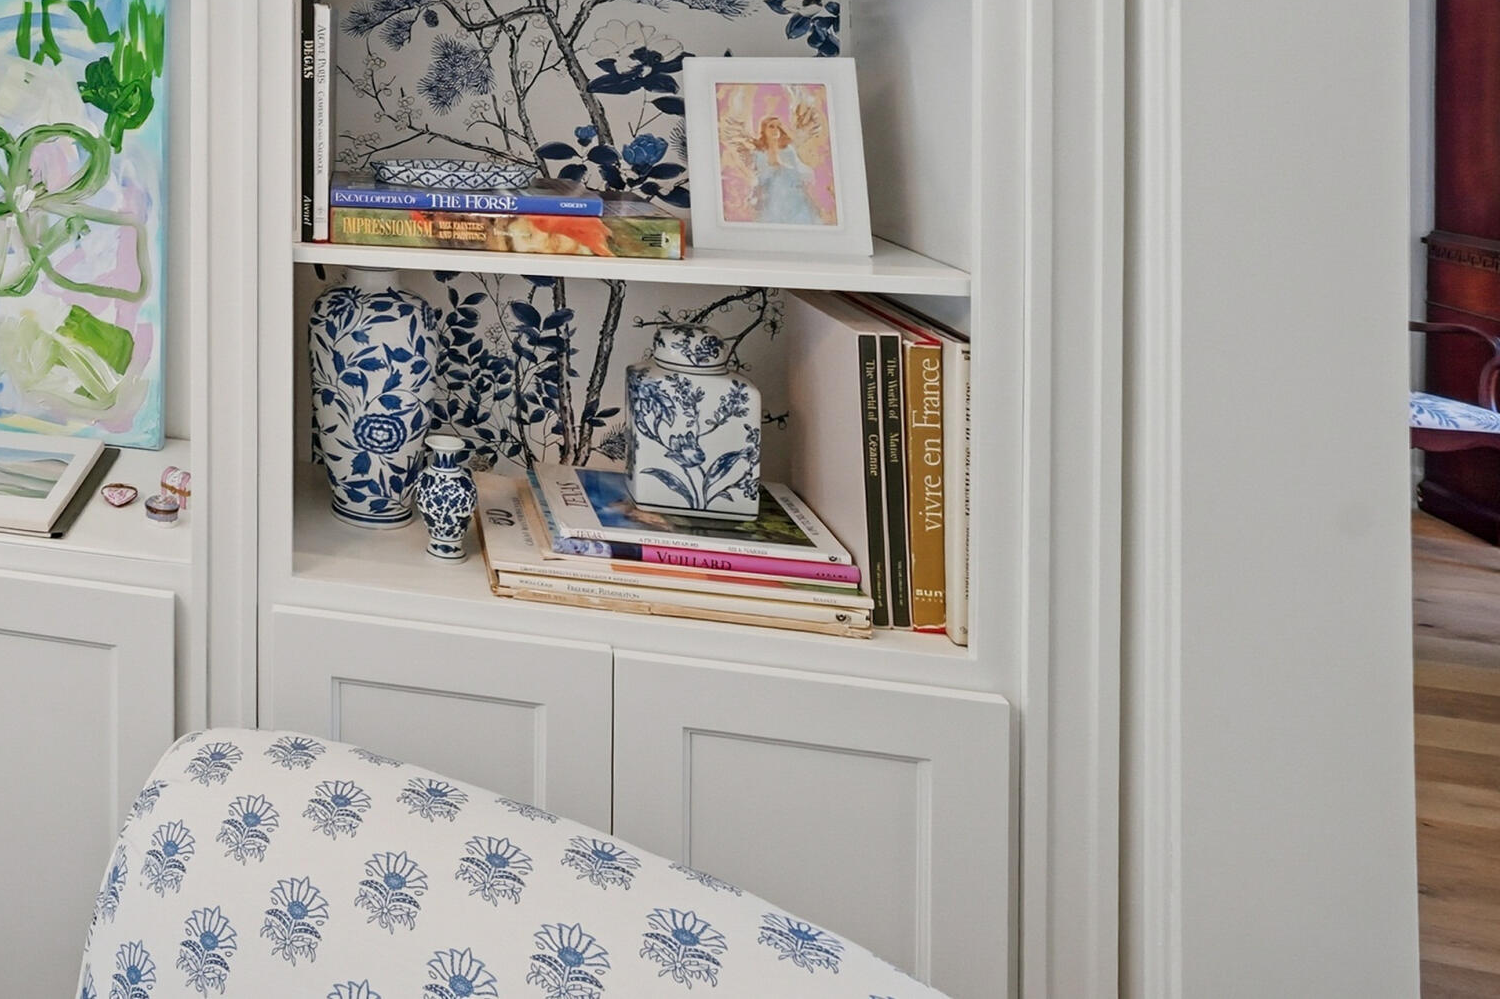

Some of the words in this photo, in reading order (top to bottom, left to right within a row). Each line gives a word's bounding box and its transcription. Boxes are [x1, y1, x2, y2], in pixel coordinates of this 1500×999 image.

[303, 39, 314, 79] DEGAS
[335, 191, 402, 205] ENCYCLOPEDIA
[426, 193, 462, 209] THE
[465, 194, 518, 211] HORSE
[342, 216, 433, 238] IMPRESSIONISM
[865, 360, 876, 379] The
[886, 357, 898, 377] The
[867, 381, 877, 411] World
[888, 379, 899, 408] World
[912, 357, 941, 429] France
[923, 438, 941, 467] en
[919, 474, 943, 532] vivre
[656, 550, 732, 571] VUILLARD
